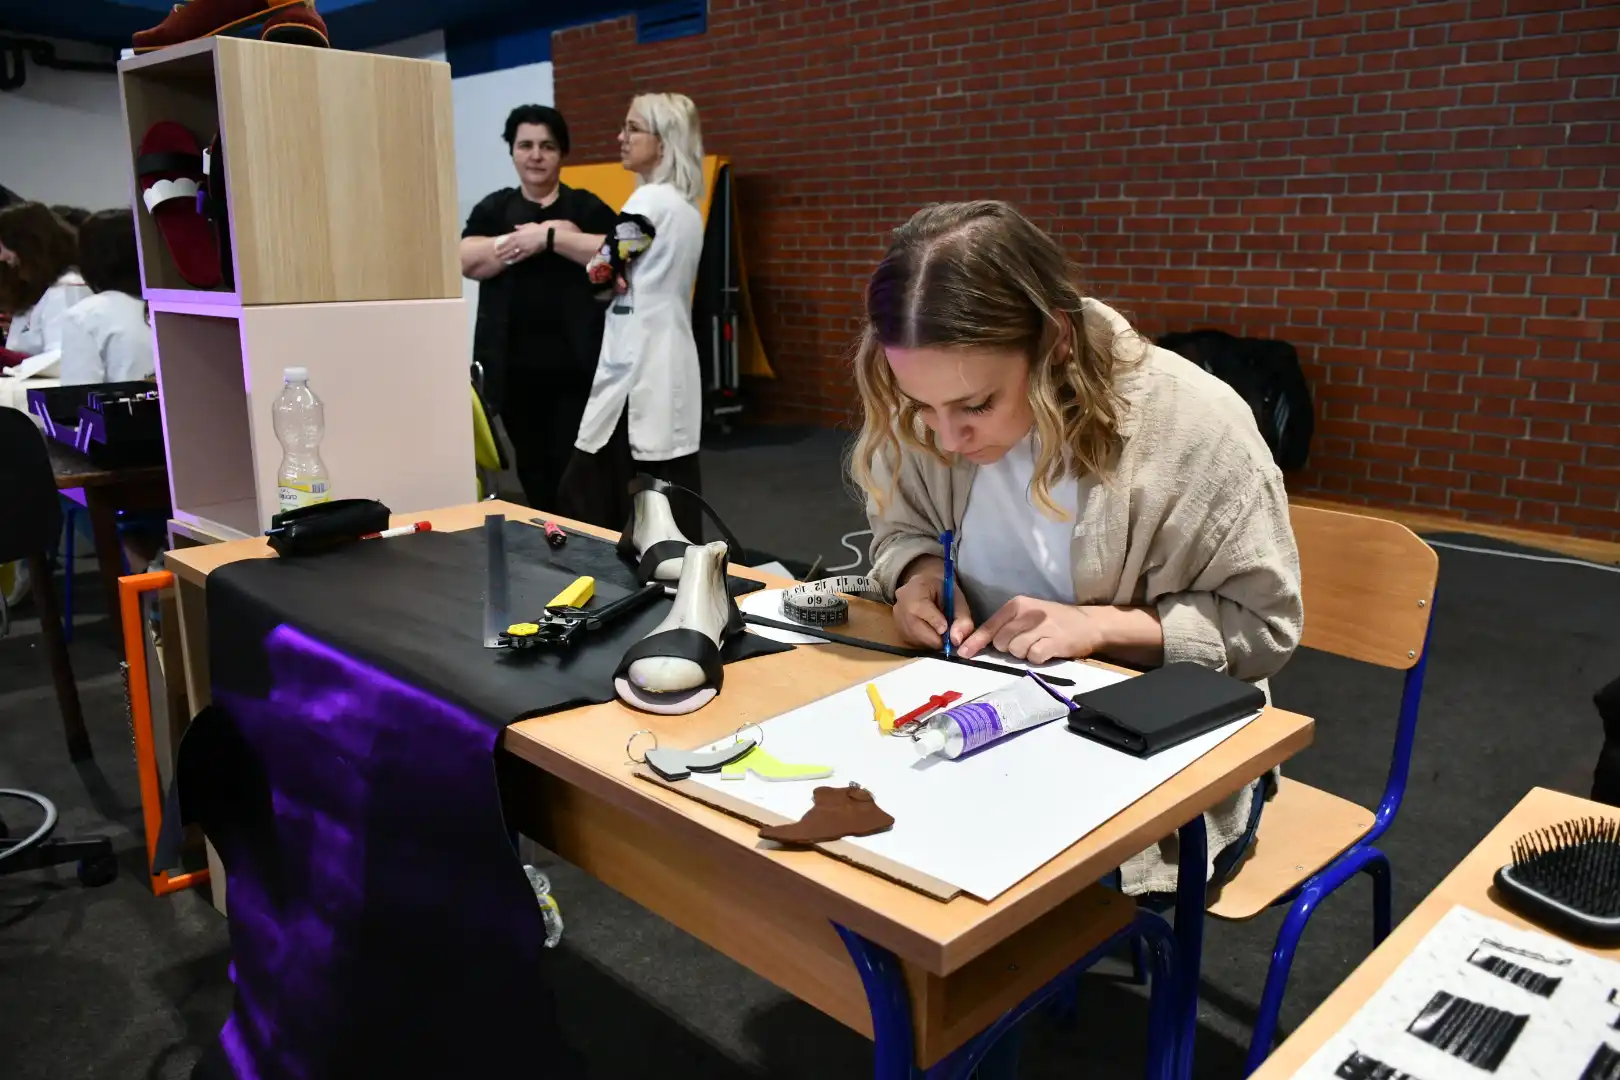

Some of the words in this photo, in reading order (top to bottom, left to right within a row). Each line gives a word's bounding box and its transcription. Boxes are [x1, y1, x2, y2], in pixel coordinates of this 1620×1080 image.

[836, 577, 849, 587] 11
[857, 577, 870, 586] 10
[815, 581, 827, 592] 12
[807, 596, 822, 605] 60
